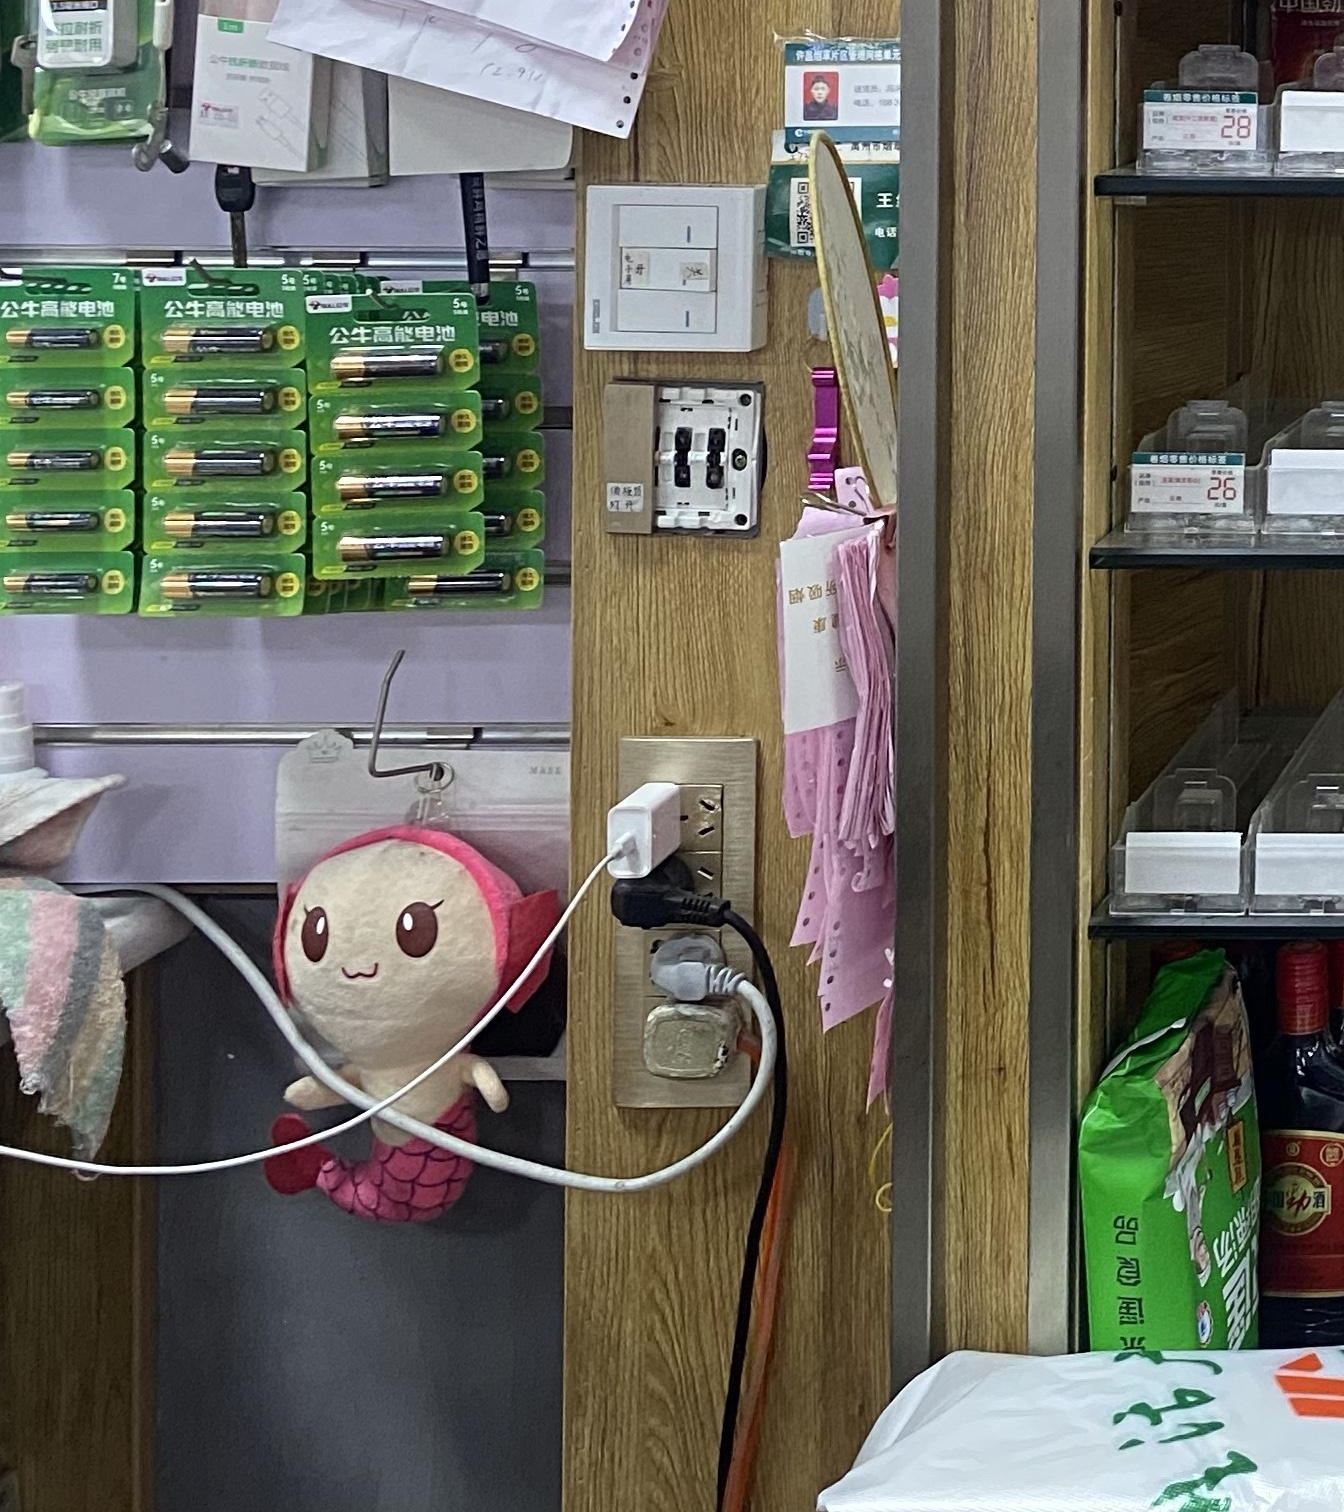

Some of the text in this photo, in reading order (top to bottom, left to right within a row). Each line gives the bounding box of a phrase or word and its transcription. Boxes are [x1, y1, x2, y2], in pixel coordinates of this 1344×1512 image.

[1220, 114, 1252, 139] 28
[876, 192, 900, 208] 王
[875, 227, 897, 238] 电话
[1, 301, 115, 319] 公牛高能电池
[164, 301, 284, 319] 公牛高能电池
